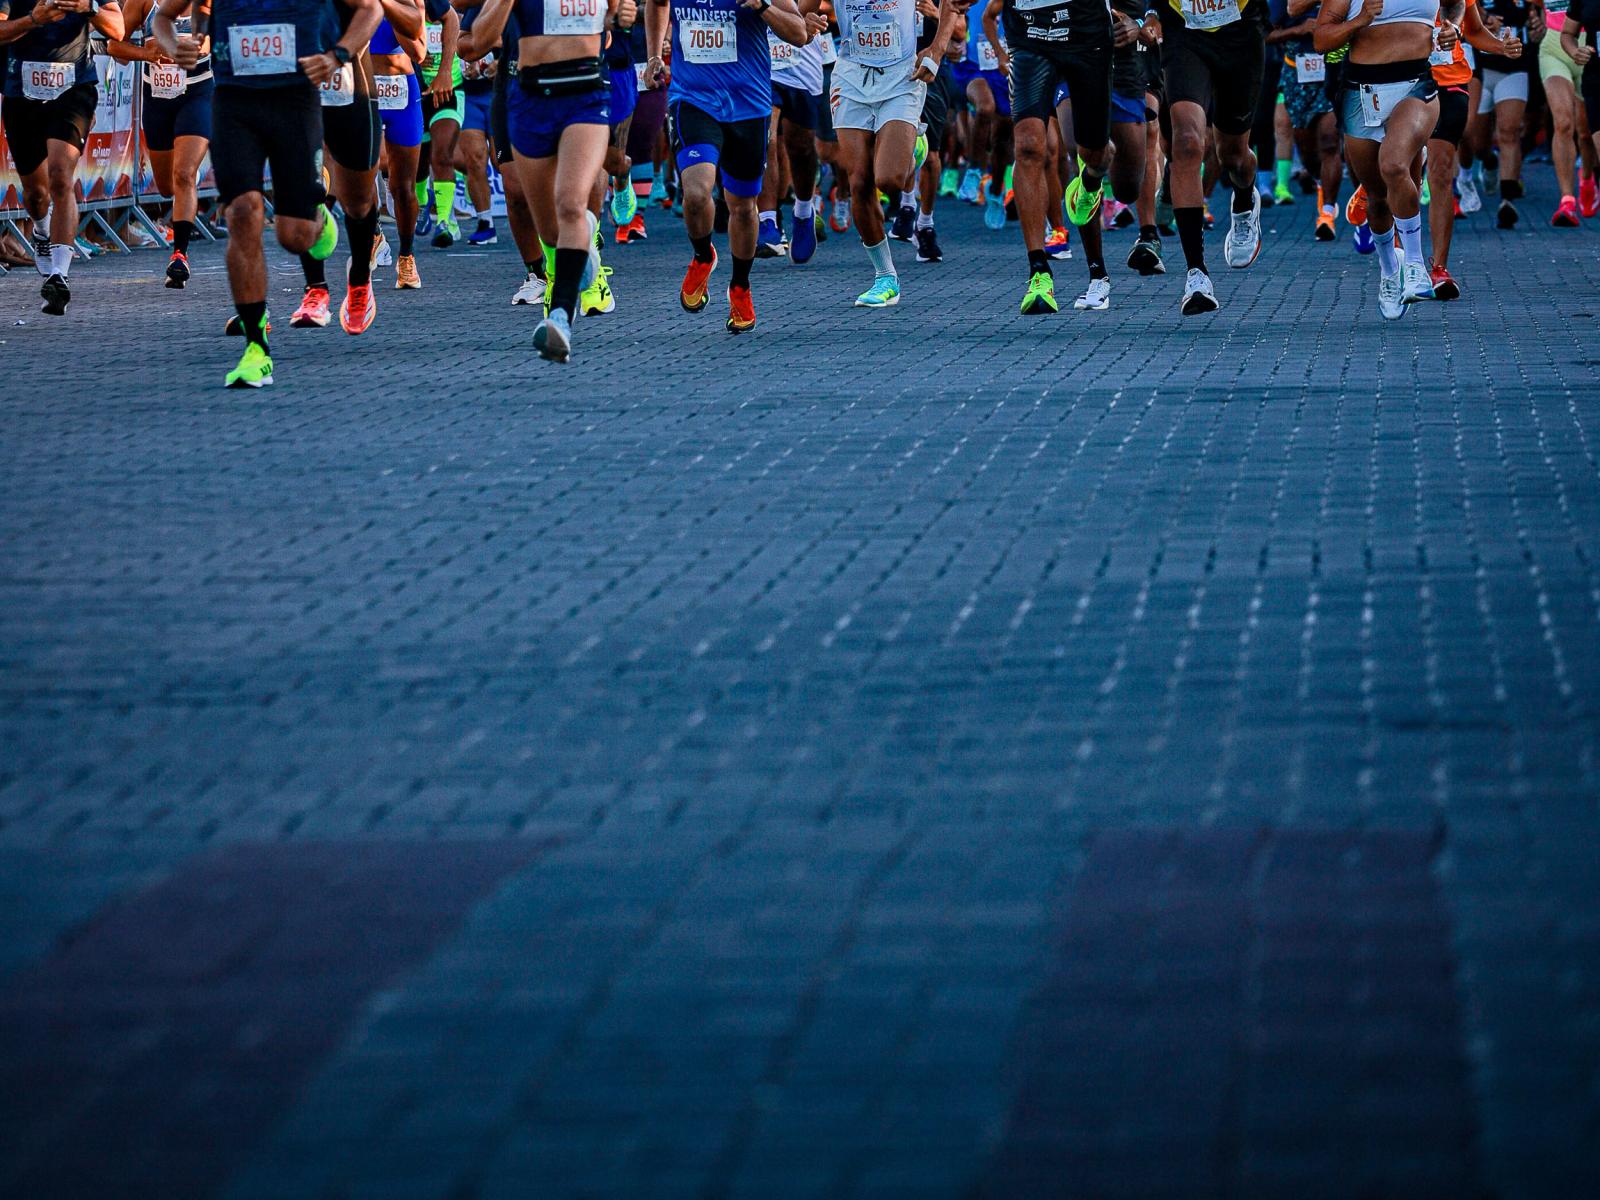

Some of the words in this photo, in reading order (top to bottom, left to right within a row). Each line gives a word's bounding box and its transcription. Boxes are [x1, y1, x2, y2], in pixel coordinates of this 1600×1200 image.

[845, 0, 898, 11] PACEMAX
[674, 7, 737, 23] RUNNERS
[241, 35, 282, 58] 6429
[689, 29, 723, 49] 7050
[857, 31, 890, 48] 6436
[31, 70, 64, 88] 6620
[153, 72, 181, 88] 6594
